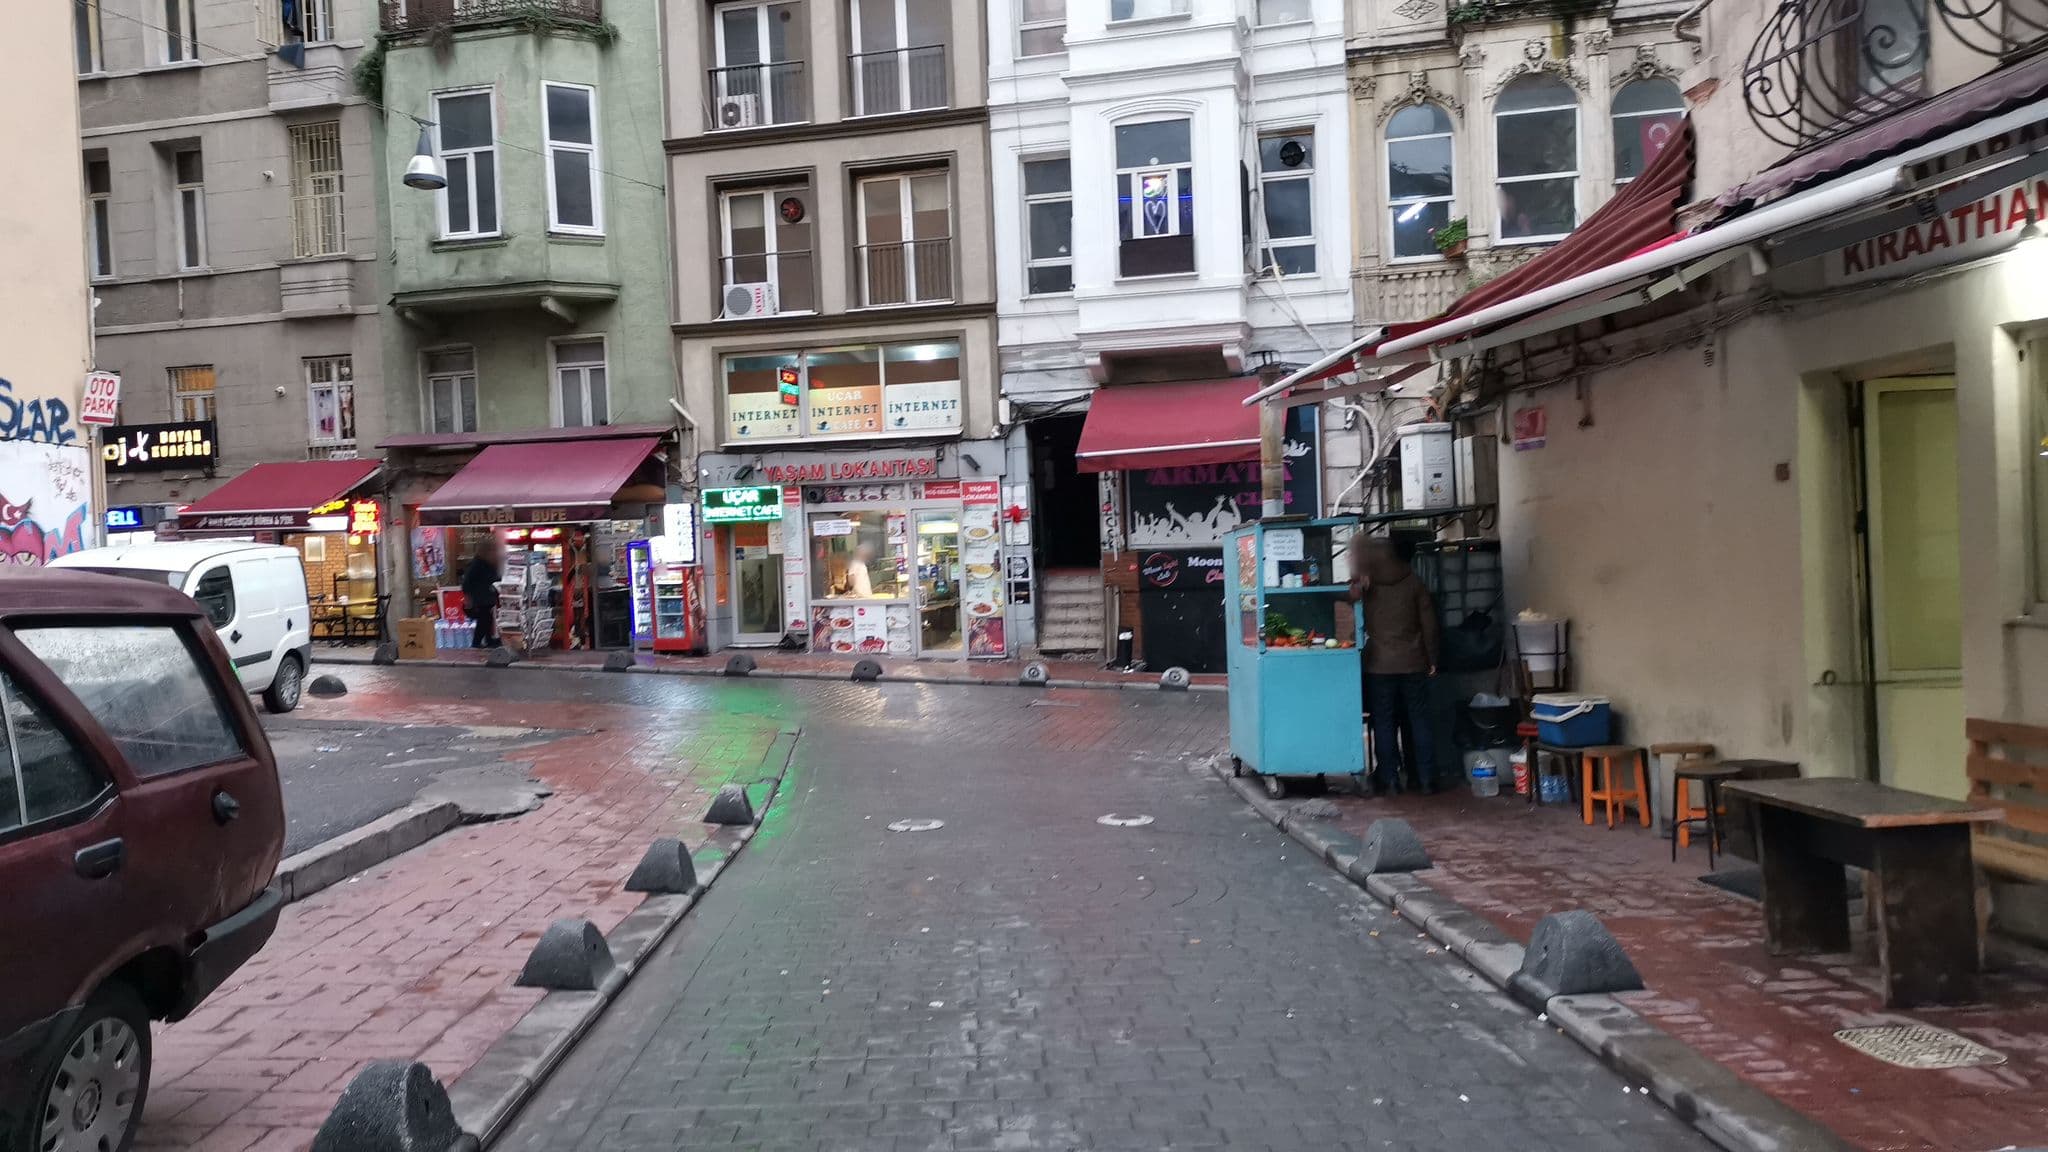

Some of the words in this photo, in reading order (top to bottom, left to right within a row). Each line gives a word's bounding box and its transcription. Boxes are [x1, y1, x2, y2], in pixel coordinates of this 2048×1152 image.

[91, 378, 115, 395] OTO
[84, 397, 115, 414] PARK
[159, 429, 202, 444] BAYAN
[764, 463, 826, 486] YAŞAM
[831, 457, 937, 480] LOKANTASI
[460, 508, 516, 524] GOLDEN
[1187, 556, 1223, 568] Moon
